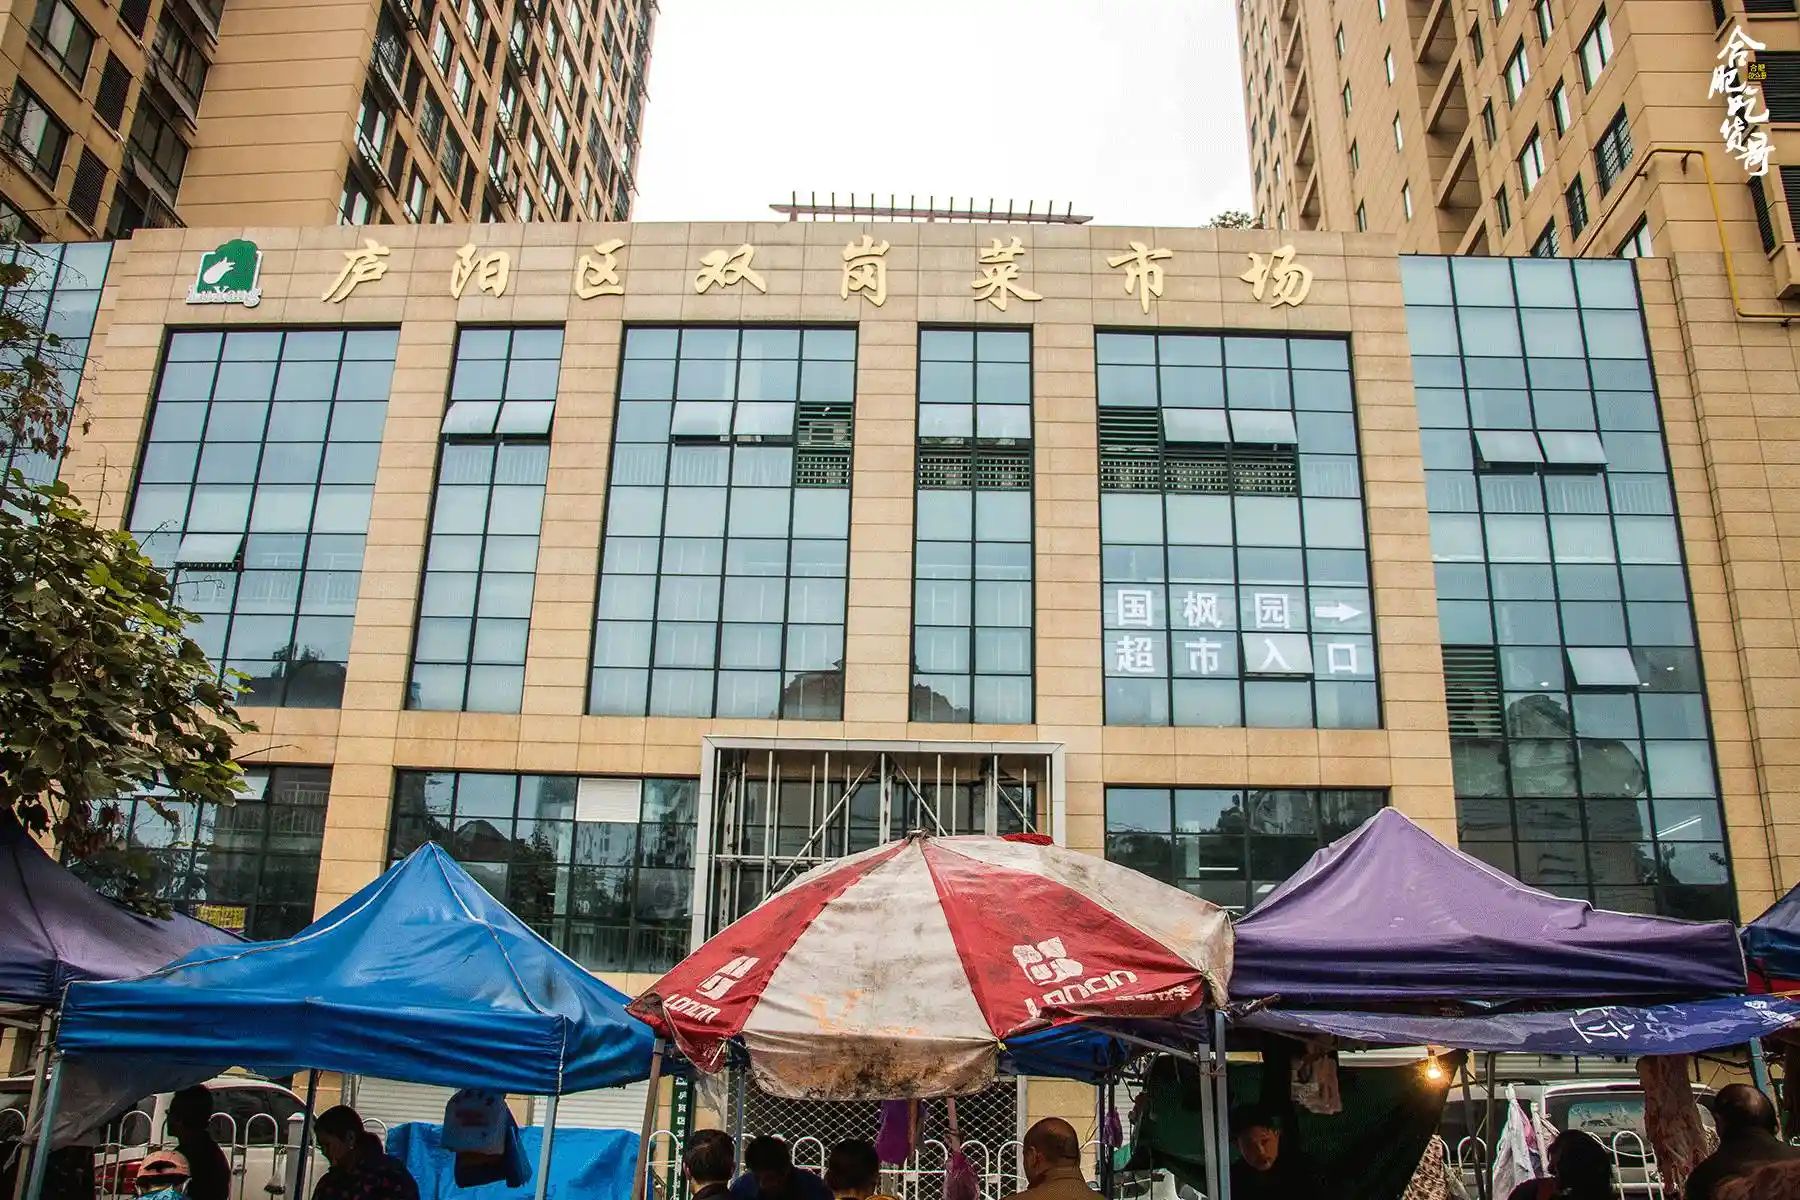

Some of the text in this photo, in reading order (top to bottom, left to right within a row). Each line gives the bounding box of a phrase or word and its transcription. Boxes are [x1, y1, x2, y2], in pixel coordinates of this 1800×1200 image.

[322, 235, 1314, 313] 庐阳区双岗菜市场
[1117, 589, 1290, 629] 国枫园
[1116, 635, 1357, 674] 超市入口
